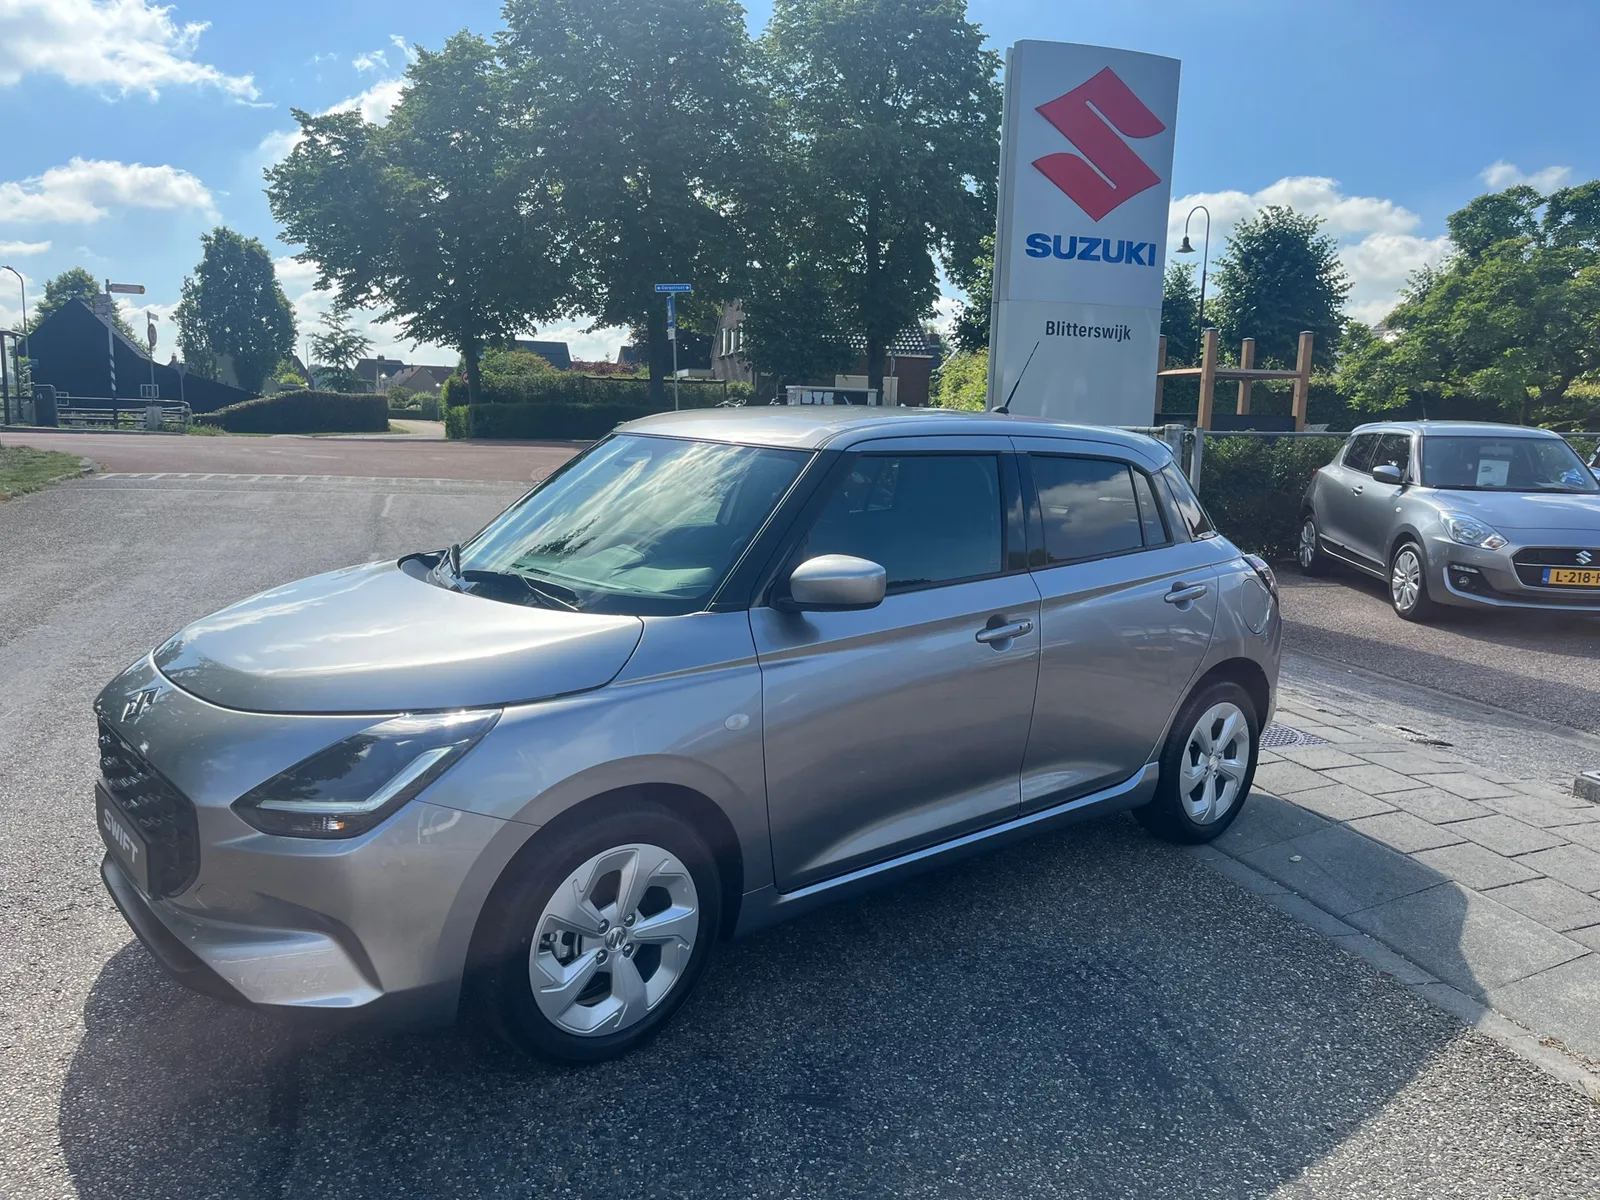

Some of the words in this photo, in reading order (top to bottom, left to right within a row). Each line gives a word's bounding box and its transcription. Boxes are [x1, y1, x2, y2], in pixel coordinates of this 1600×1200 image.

[1025, 233, 1157, 267] SUZUKI
[1045, 320, 1131, 342] Blitterswijk
[103, 808, 138, 863] SWIFT
